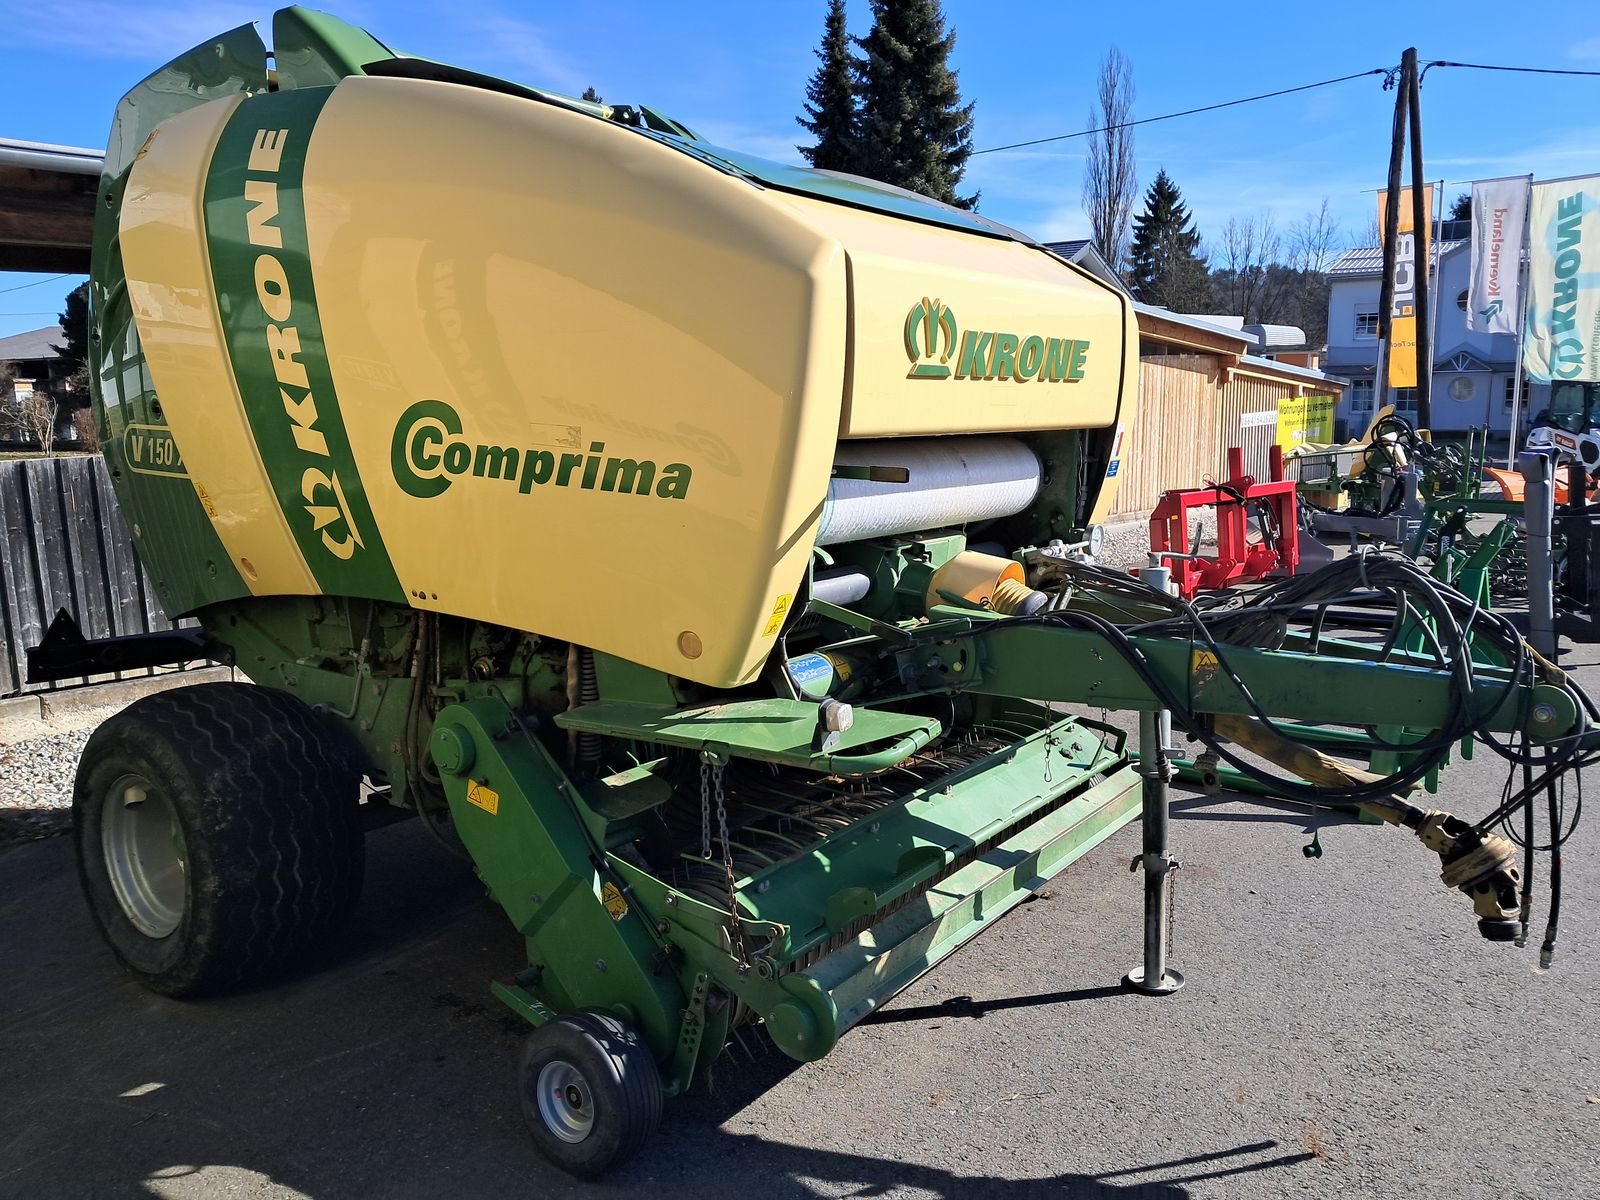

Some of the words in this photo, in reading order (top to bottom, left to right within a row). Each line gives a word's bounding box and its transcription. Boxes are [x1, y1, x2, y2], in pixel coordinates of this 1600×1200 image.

[245, 128, 331, 458] KRONE
[953, 329, 1091, 384] KRONE
[131, 435, 144, 462] V
[148, 437, 173, 466] 150
[390, 399, 694, 500] Comprima
